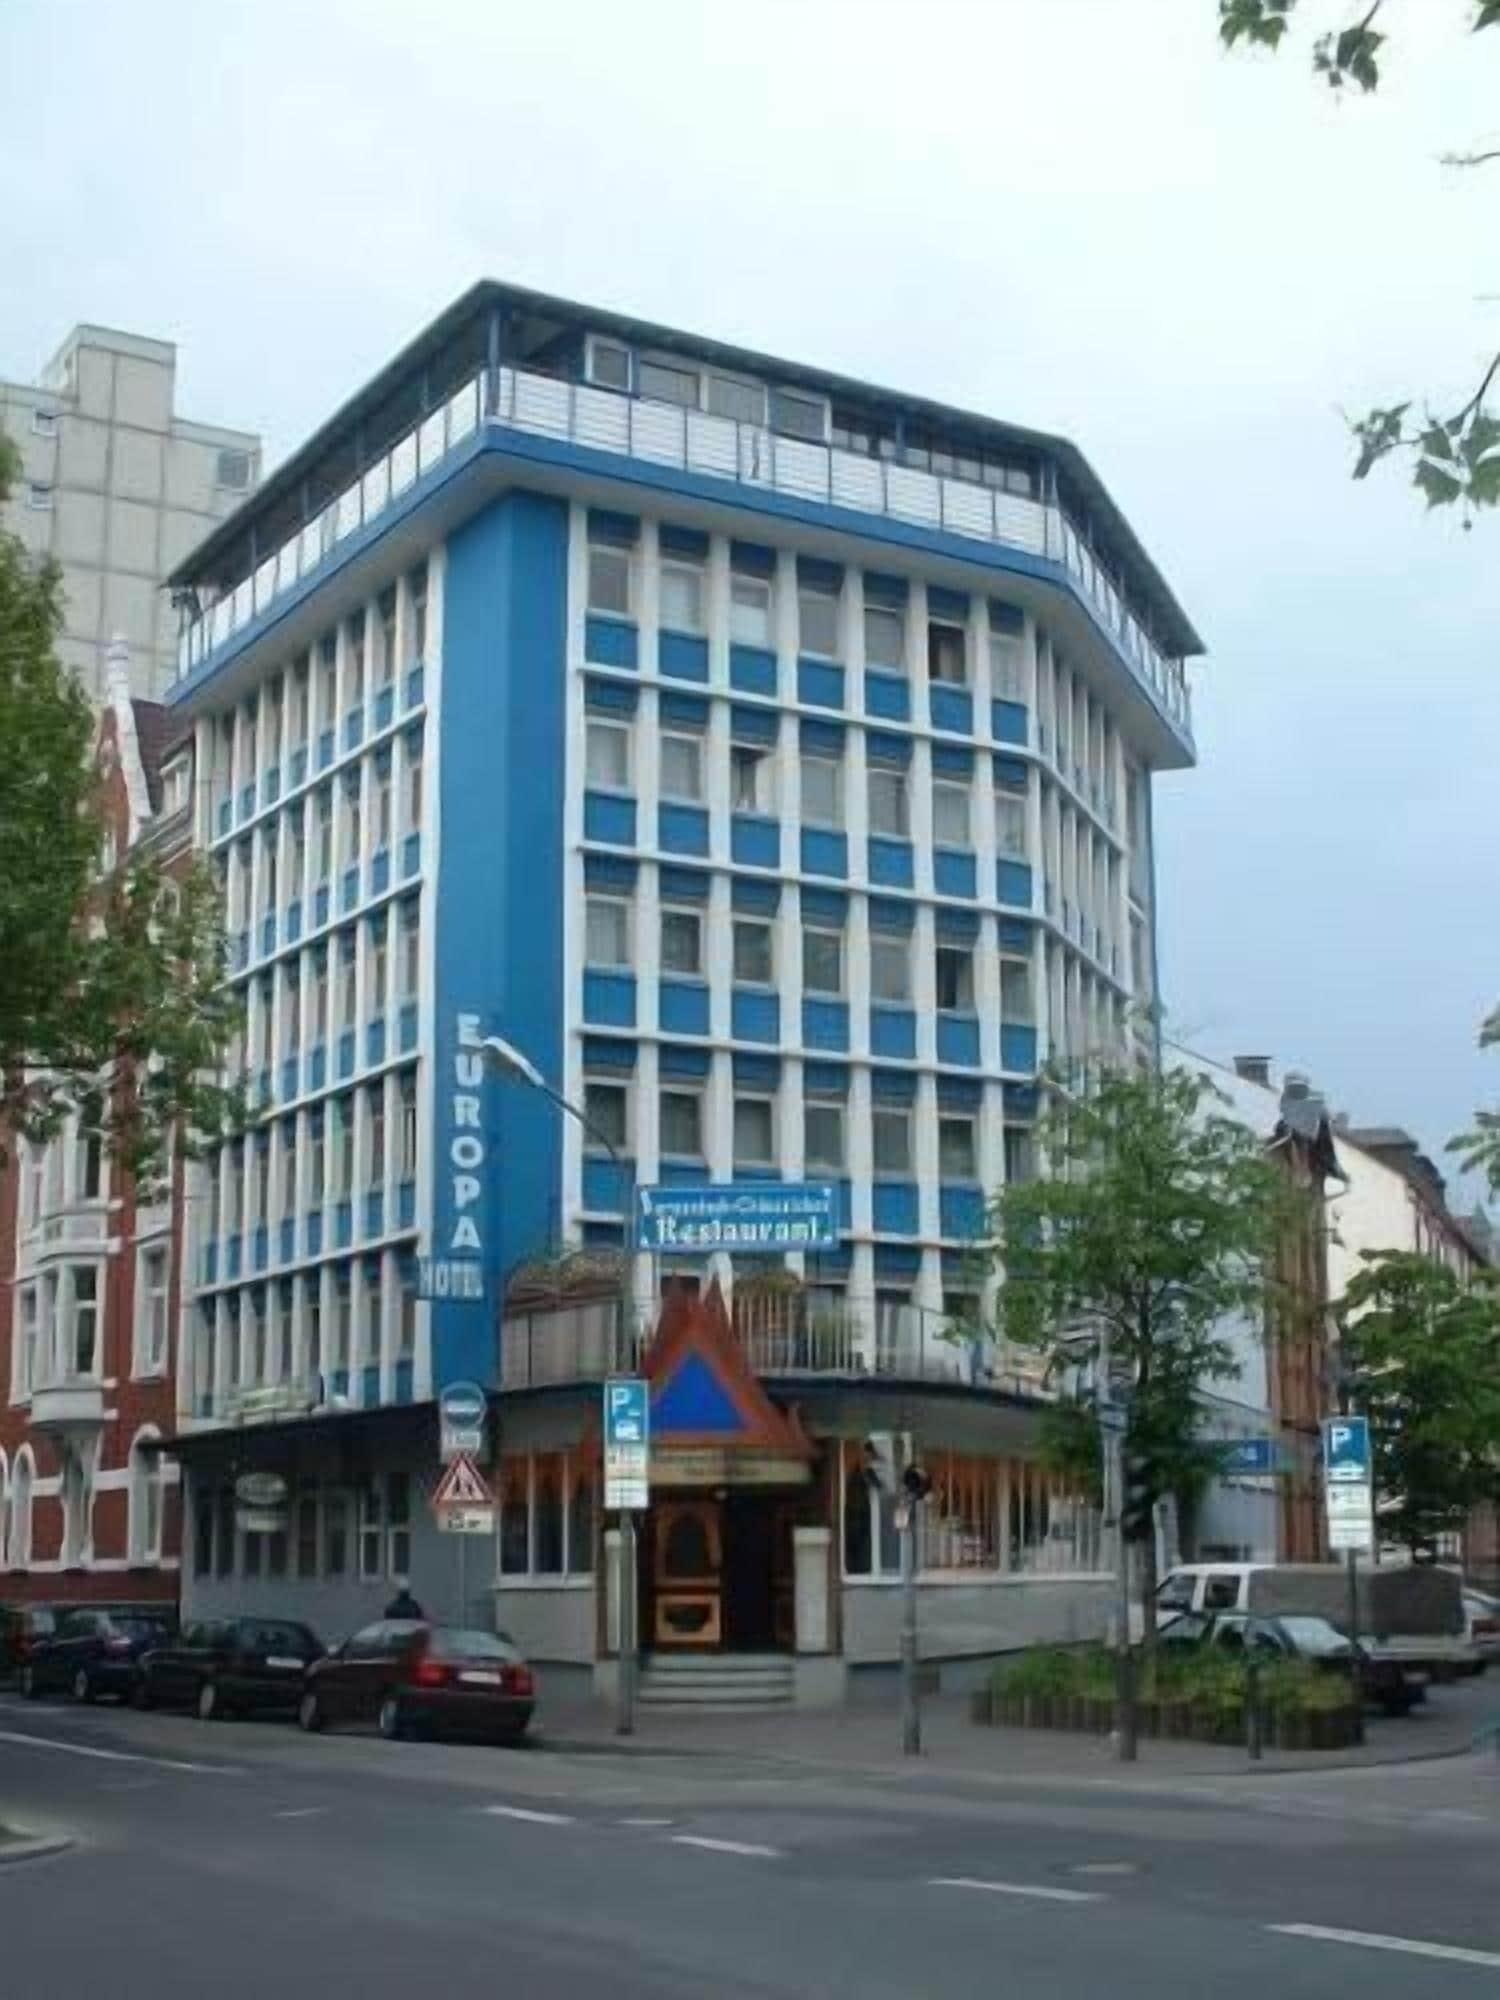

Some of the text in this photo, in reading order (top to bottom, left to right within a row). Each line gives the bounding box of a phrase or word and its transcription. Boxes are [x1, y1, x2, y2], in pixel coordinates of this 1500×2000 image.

[451, 1012, 484, 1249] EUROPA
[655, 1215, 817, 1243] Restaurant
[611, 1387, 632, 1416] P
[1331, 1427, 1352, 1454] P
